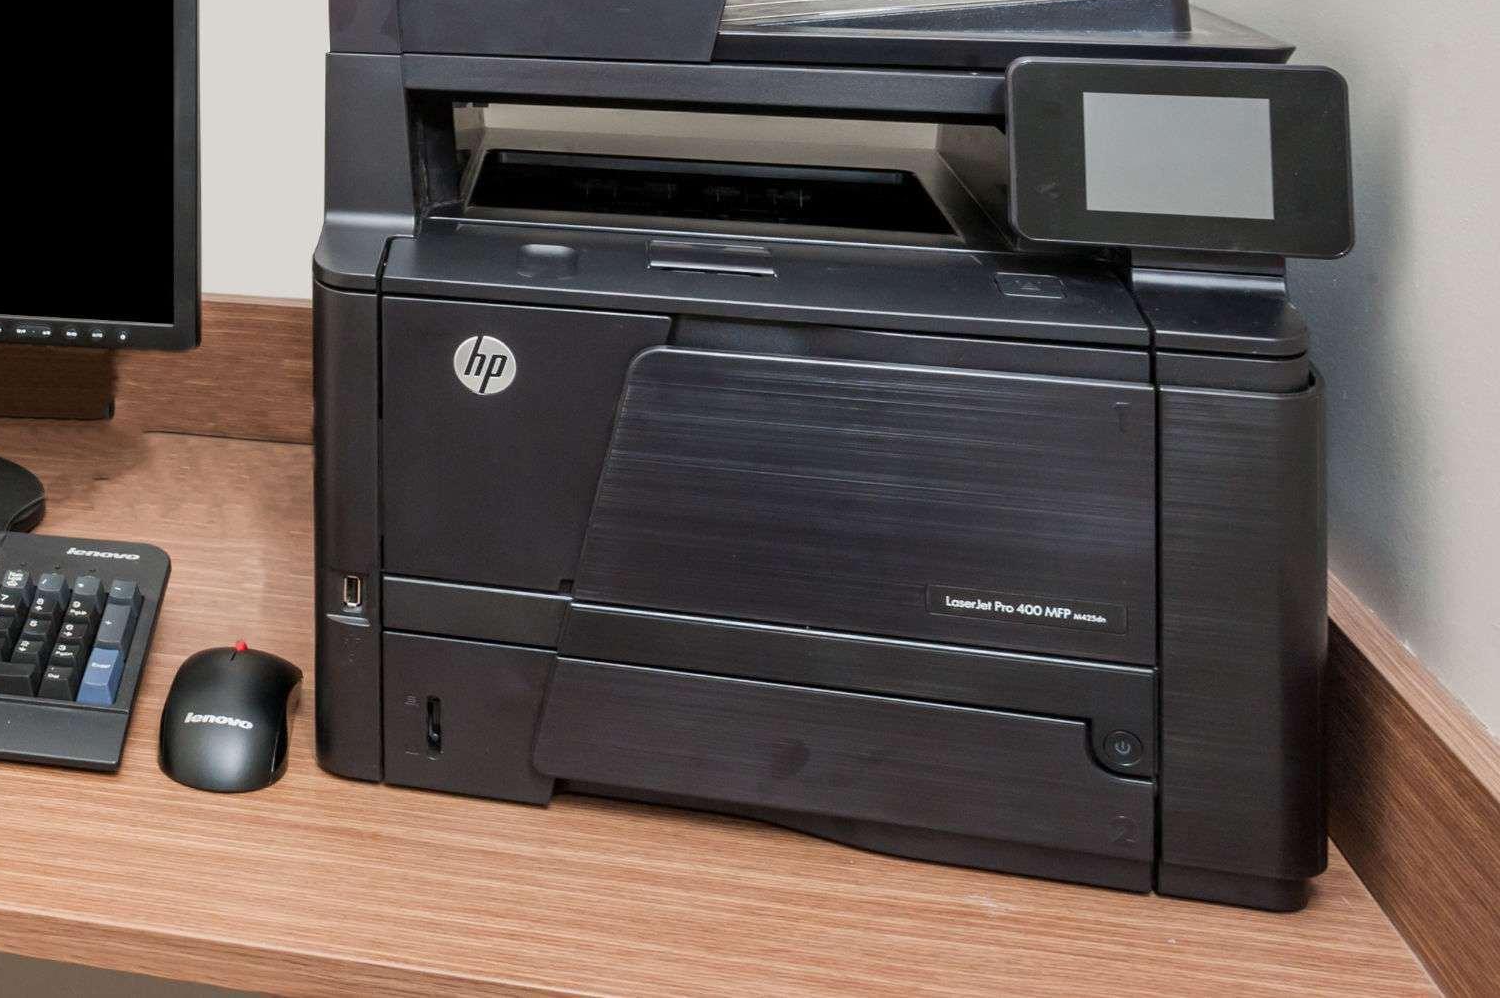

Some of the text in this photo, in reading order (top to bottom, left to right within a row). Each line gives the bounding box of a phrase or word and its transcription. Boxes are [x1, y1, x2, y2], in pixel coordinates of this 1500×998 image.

[463, 335, 508, 394] hp
[66, 547, 141, 560] lenovo
[945, 595, 993, 612] LaserJet
[994, 601, 1015, 614] Pro
[1016, 603, 1043, 617] 400
[1044, 605, 1073, 620] MFP
[184, 712, 254, 729] lenovo
